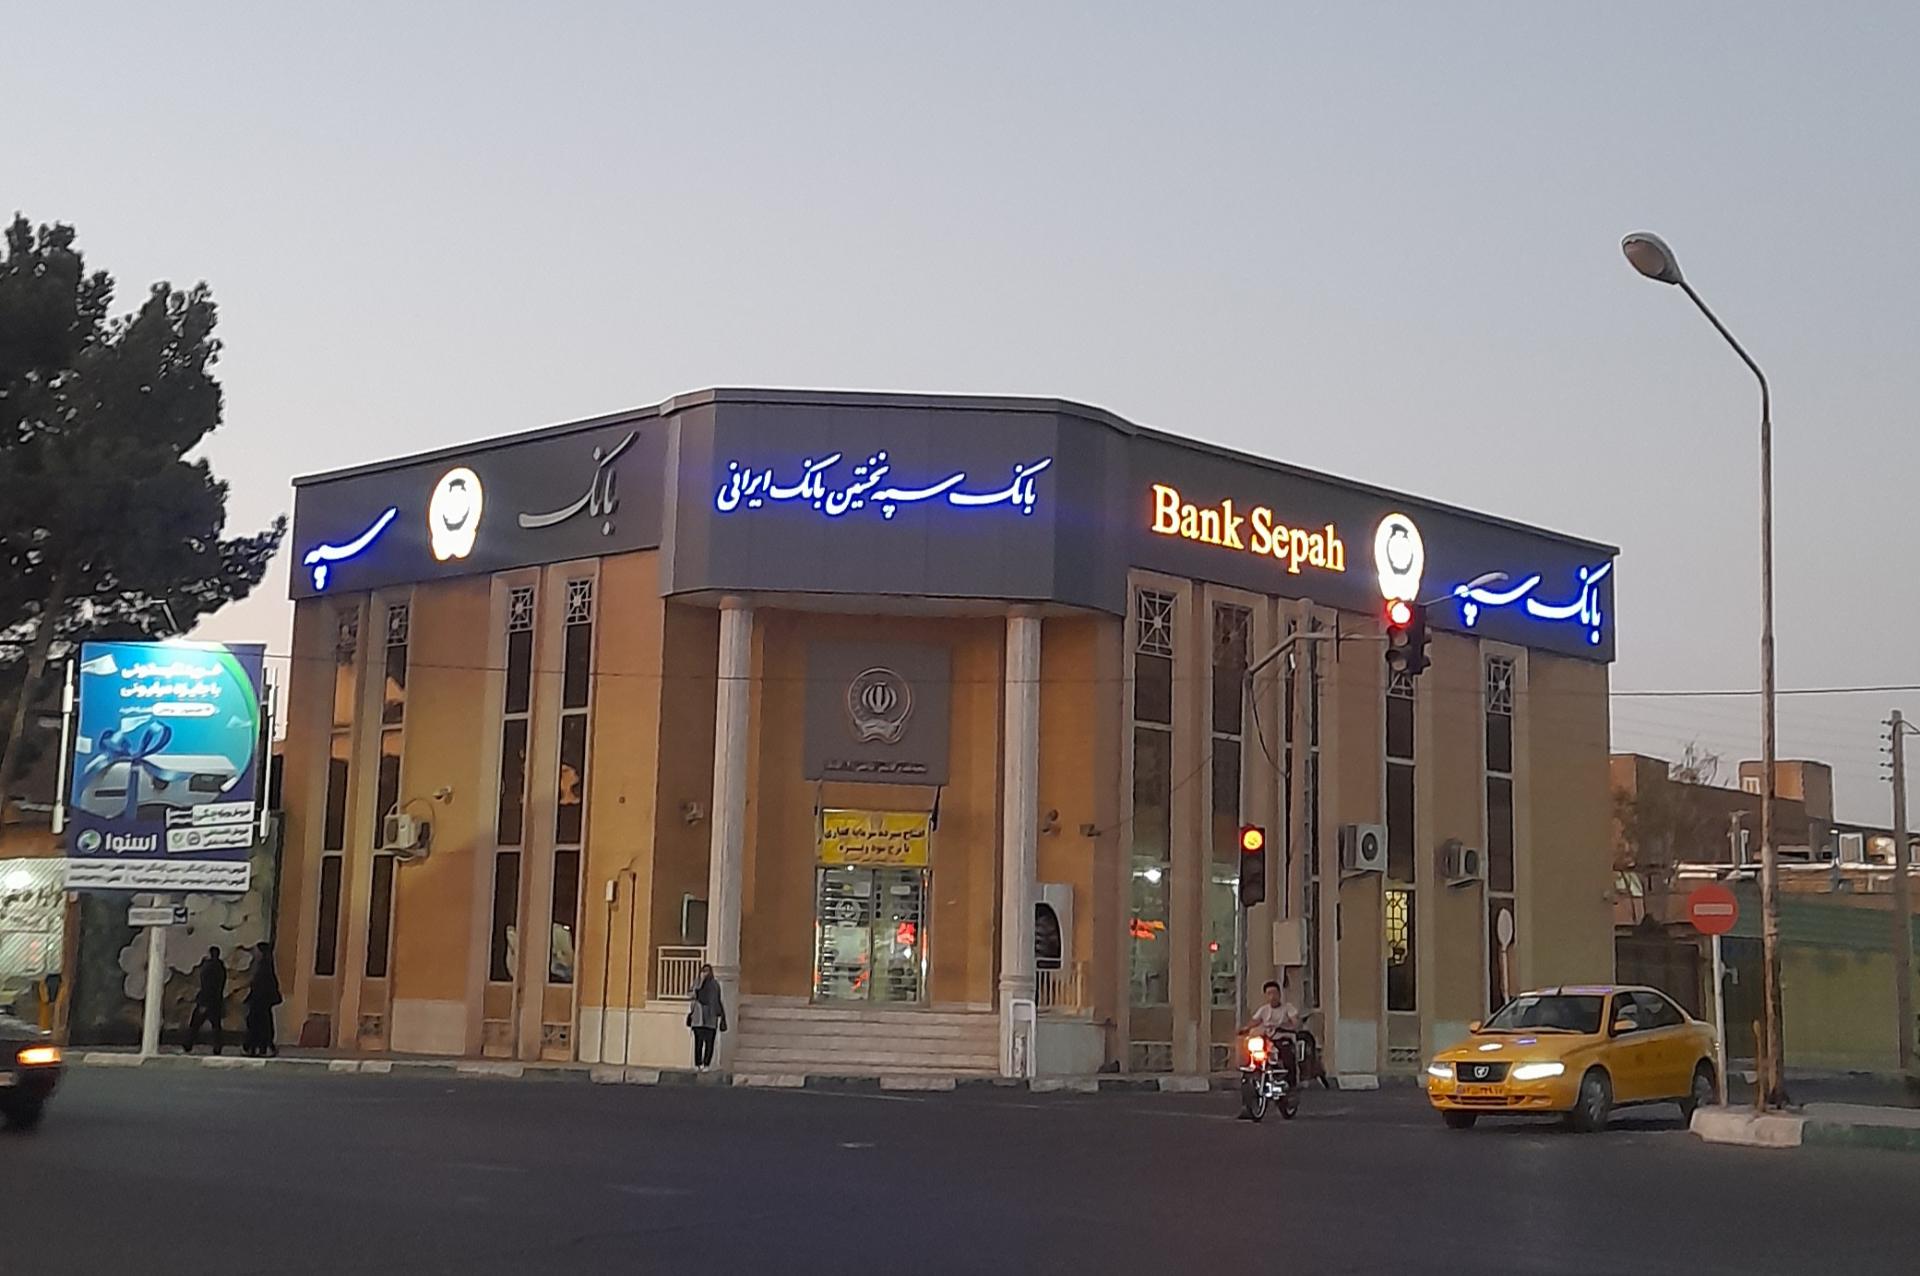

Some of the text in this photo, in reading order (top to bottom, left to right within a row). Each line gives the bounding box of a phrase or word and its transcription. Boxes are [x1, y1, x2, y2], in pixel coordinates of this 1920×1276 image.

[303, 431, 639, 591] بانک سپه
[716, 450, 1053, 519] بانک سپه نخستین بانک ایرانی
[1151, 483, 1346, 574] Bank Sepah
[1453, 562, 1612, 645] بانک سپه
[105, 832, 158, 854] اسنوا
